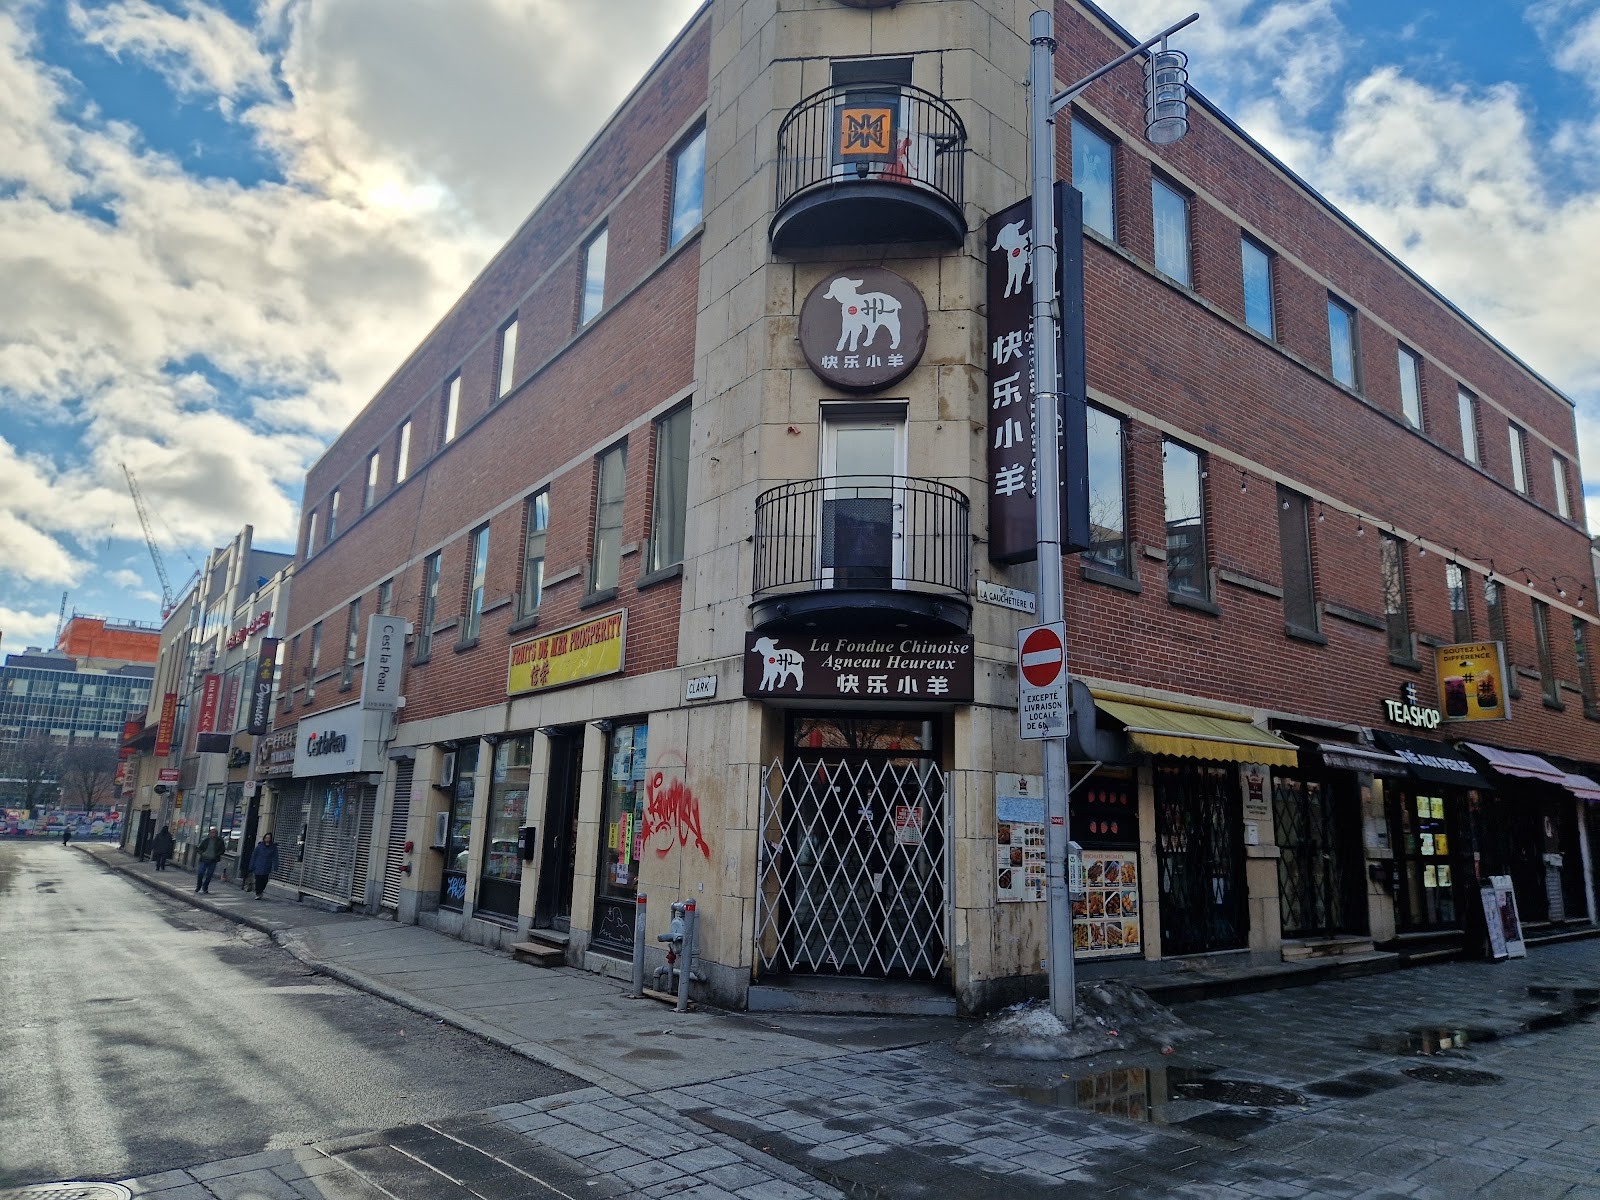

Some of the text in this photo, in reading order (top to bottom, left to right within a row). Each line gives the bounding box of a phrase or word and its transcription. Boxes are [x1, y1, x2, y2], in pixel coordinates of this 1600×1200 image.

[821, 353, 905, 370] 快乐小羊
[992, 329, 1026, 497] 快乐小羊
[980, 590, 988, 599] LA
[538, 638, 549, 660] DE
[550, 634, 568, 657] MER
[569, 614, 622, 652] PROSPERITY
[809, 638, 971, 655] La Fondue Chinoise
[1476, 644, 1486, 652] LA
[380, 653, 391, 664] la
[821, 654, 956, 671] Agneau Heureux
[377, 665, 390, 692] Peau
[836, 673, 950, 696] 快乐小羊
[688, 681, 710, 694] CLARK
[1027, 690, 1059, 703] EXCEPTÉ
[1024, 701, 1062, 712] LIVRAISON
[1384, 699, 1441, 729] TEASHOP
[1029, 711, 1057, 721] LOCALE
[1026, 722, 1036, 730] DE
